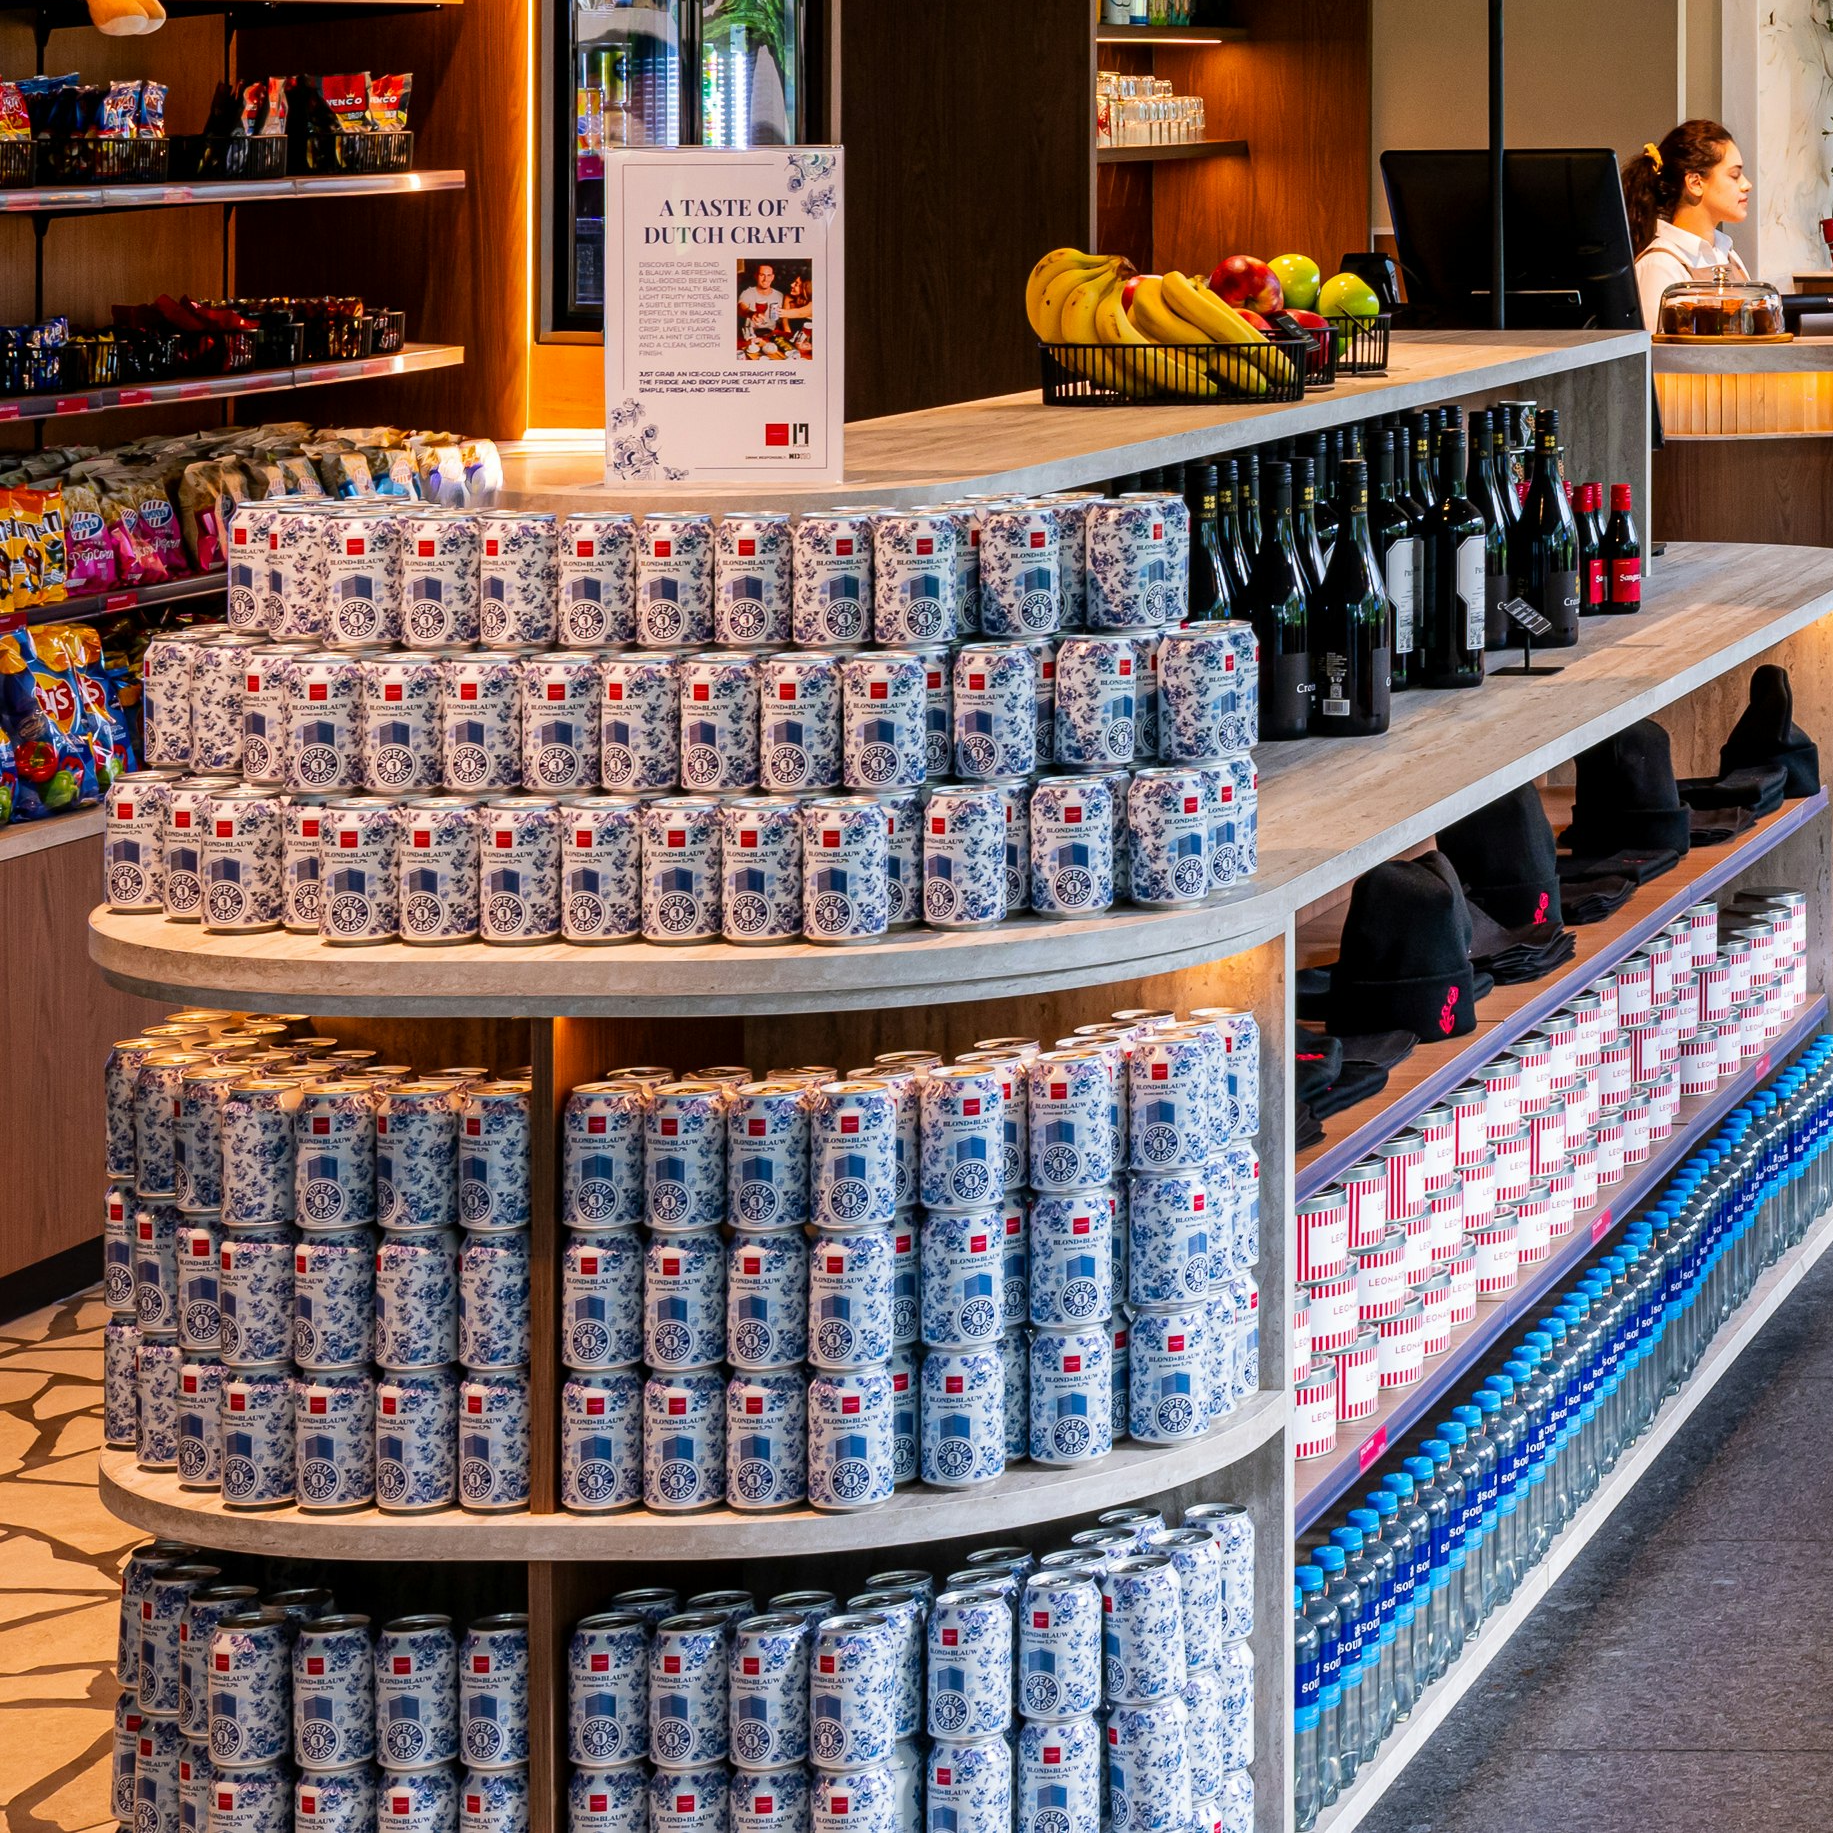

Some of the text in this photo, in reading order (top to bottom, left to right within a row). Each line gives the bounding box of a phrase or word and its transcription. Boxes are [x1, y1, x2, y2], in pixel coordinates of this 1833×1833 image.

[659, 199, 789, 217] A TASTE OF
[644, 226, 805, 244] DUTCH CRAFT
[829, 603, 858, 621] JOPEN
[302, 748, 333, 767] JOPEN
[1057, 870, 1086, 888] JOPEN
[833, 1181, 862, 1199] JOPEN
